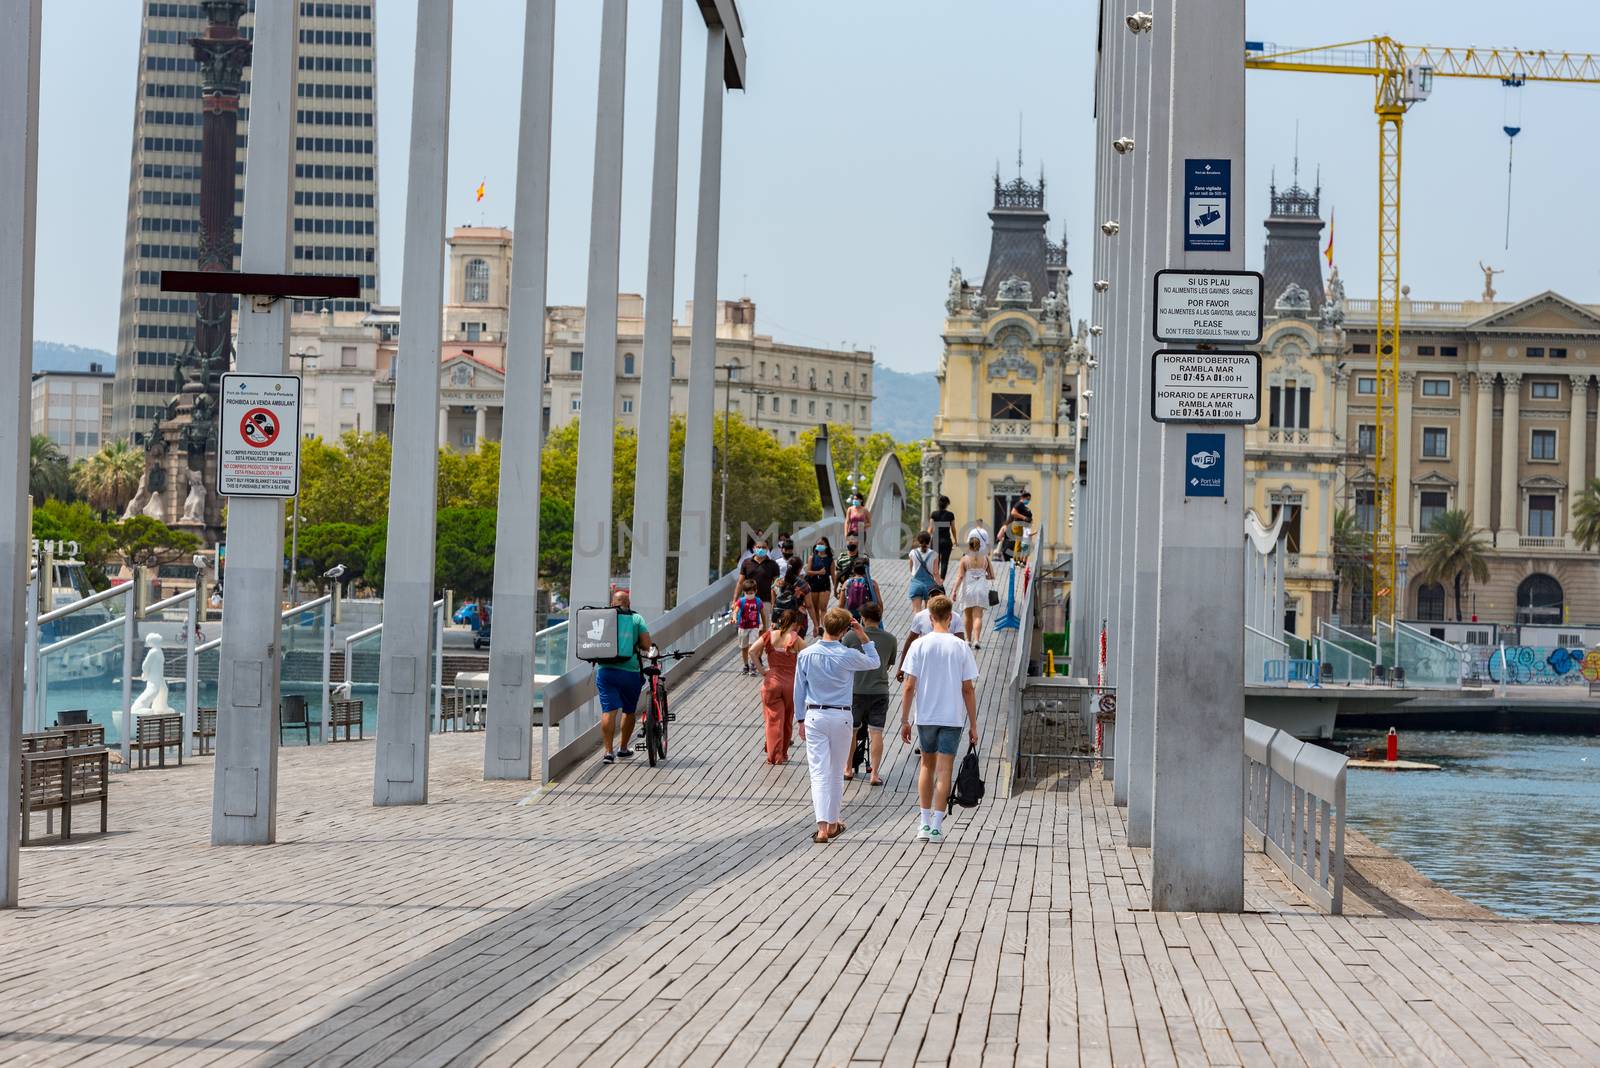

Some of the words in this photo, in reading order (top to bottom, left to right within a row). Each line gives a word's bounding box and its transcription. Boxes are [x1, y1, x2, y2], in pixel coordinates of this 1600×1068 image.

[1210, 278, 1230, 286] PLAU
[1206, 300, 1230, 308] FAVOR
[1194, 320, 1222, 328] PLEASE
[1198, 356, 1250, 364] D'OBERTURA
[1214, 374, 1234, 382] 01:00
[1214, 400, 1232, 408] MAR
[1182, 408, 1204, 416] 07:45
[1212, 410, 1234, 418] 01:00
